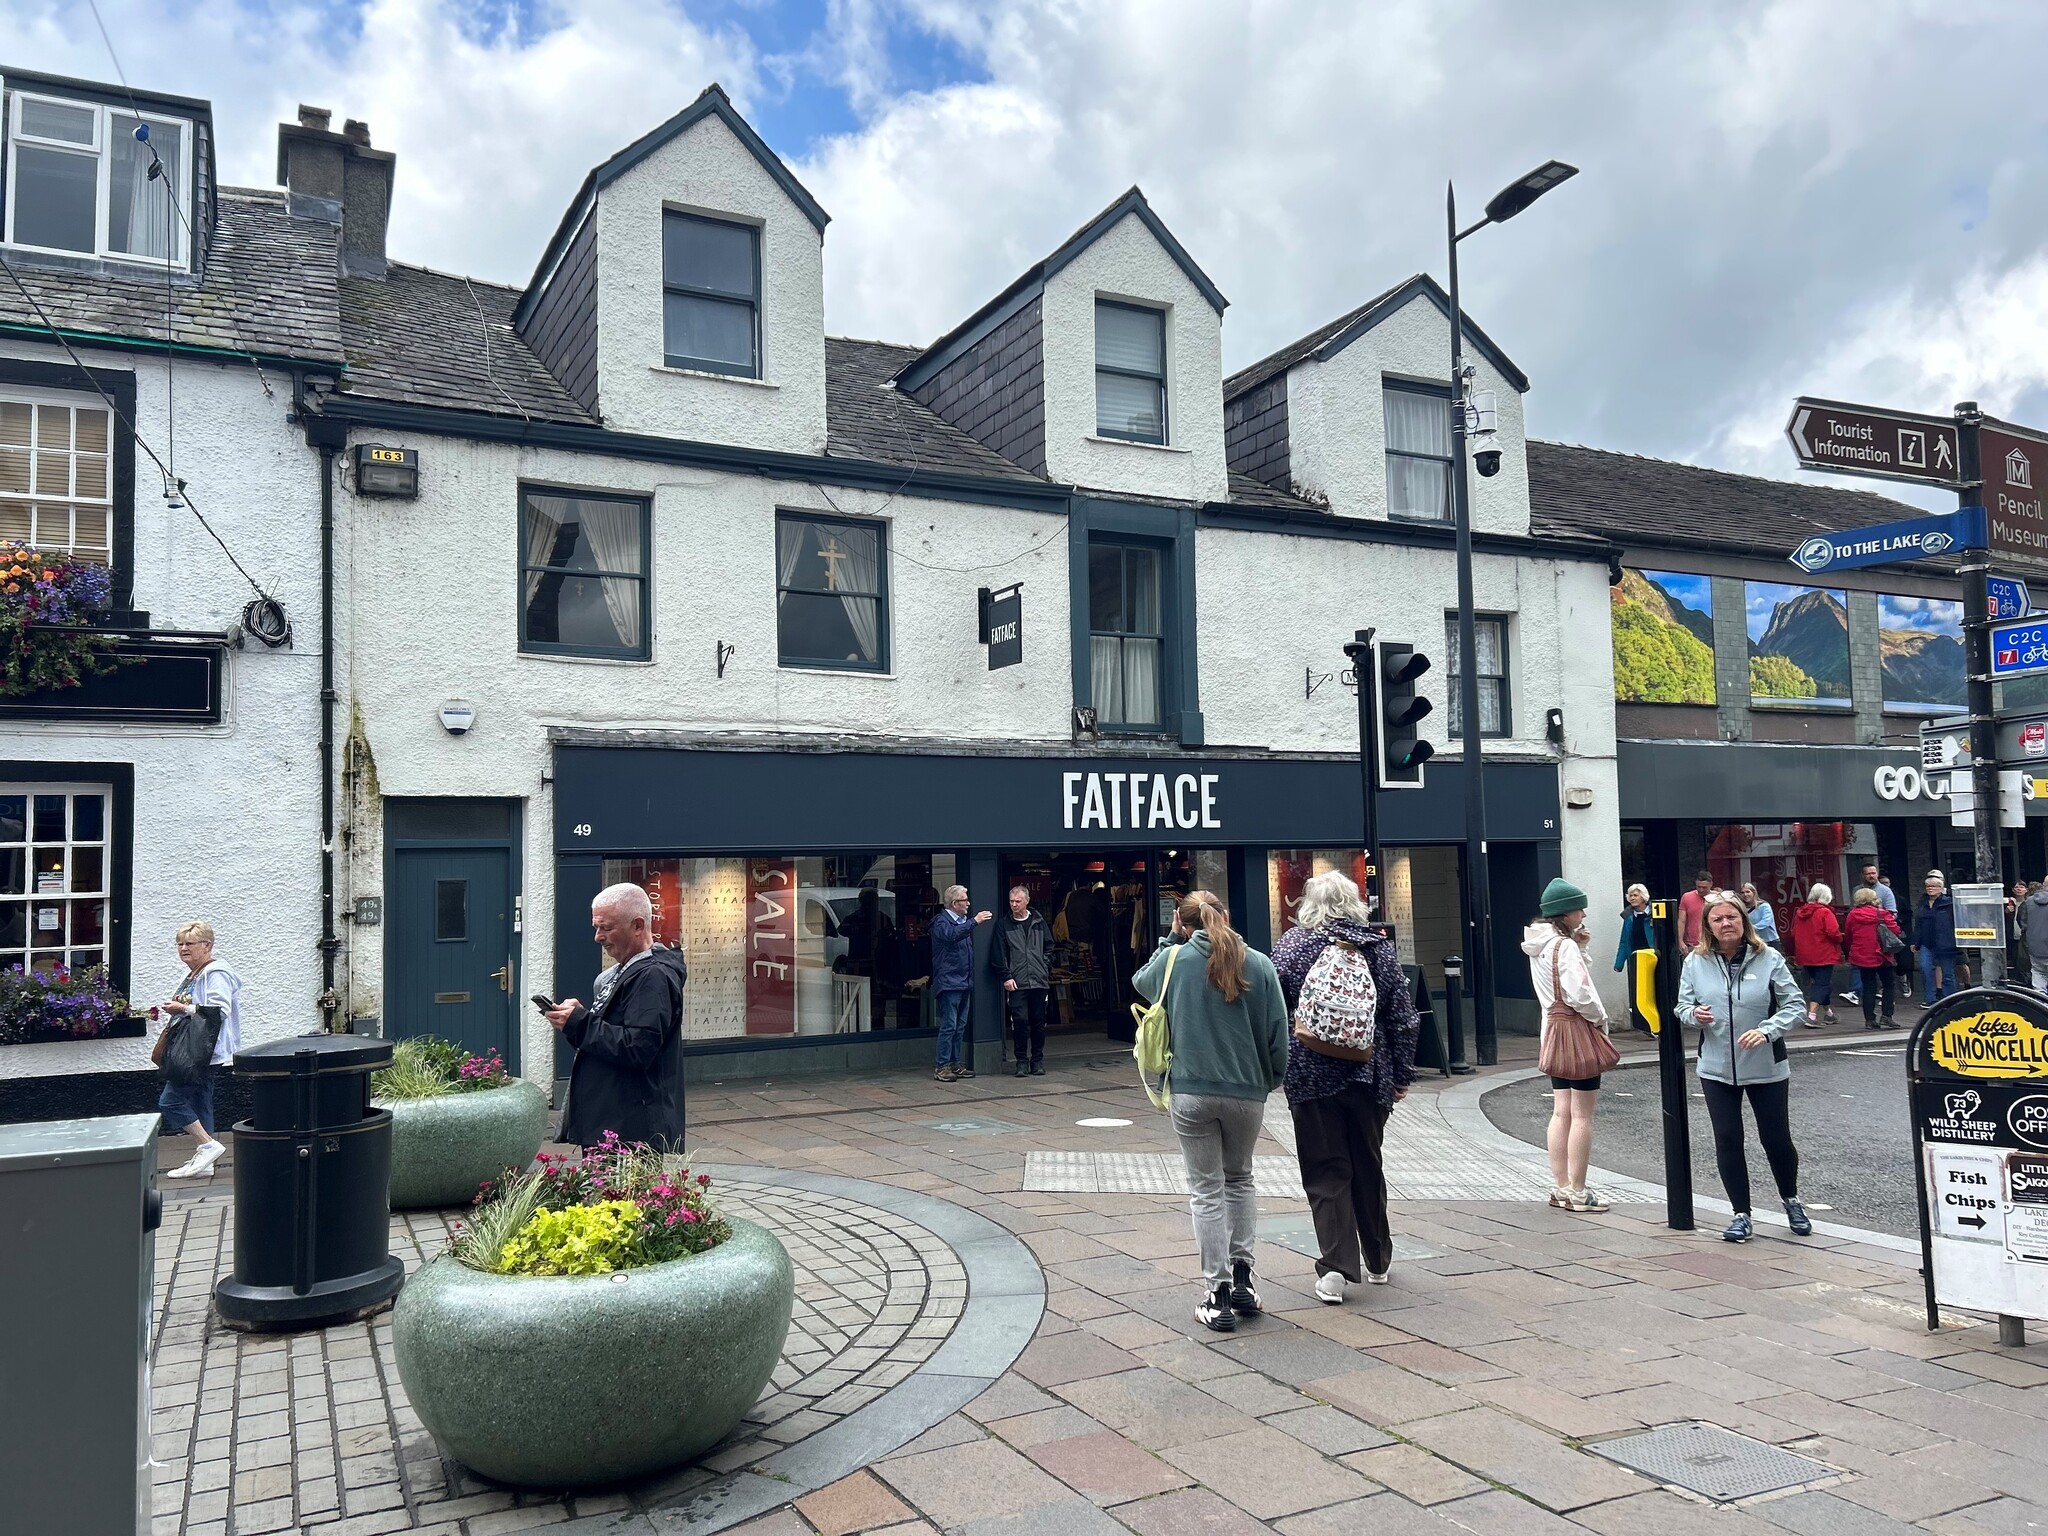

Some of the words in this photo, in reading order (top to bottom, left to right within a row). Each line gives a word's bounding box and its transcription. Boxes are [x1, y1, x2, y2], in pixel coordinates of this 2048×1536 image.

[1828, 419, 1873, 441] Tourist
[374, 450, 402, 461] 163
[1814, 437, 1891, 463] Information
[1998, 492, 2044, 521] Pencil
[1833, 546, 1852, 559] TO
[1854, 540, 1881, 556] THE
[1883, 533, 1921, 551] LAKE
[1992, 583, 2011, 596] C2C
[1991, 600, 1996, 612] 7
[991, 621, 1017, 646] FATFACE
[2002, 650, 2012, 664] 7
[1062, 772, 1221, 829] FATFACE
[573, 823, 592, 836] 49
[1543, 819, 1554, 829] 51
[1367, 866, 1375, 875] 2
[1774, 850, 1825, 877] SALE
[1388, 881, 1409, 889] SALE
[1652, 904, 1660, 917] 1
[752, 868, 789, 981] SALE
[1968, 1015, 2017, 1038] Lakes
[1953, 1098, 1966, 1108] 73
[2024, 1105, 2048, 1119] PO
[1929, 1117, 1959, 1128] WILD
[1962, 1121, 1997, 1131] SHEEP
[2016, 1120, 2048, 1133] OFF
[1931, 1127, 1996, 1141] DISTILLERY
[2021, 1163, 2048, 1174] LITTL
[1948, 1170, 1988, 1185] Fish
[2012, 1172, 2048, 1191] SAIGO
[1945, 1193, 1996, 1210] Chips
[2024, 1208, 2048, 1218] LAKE
